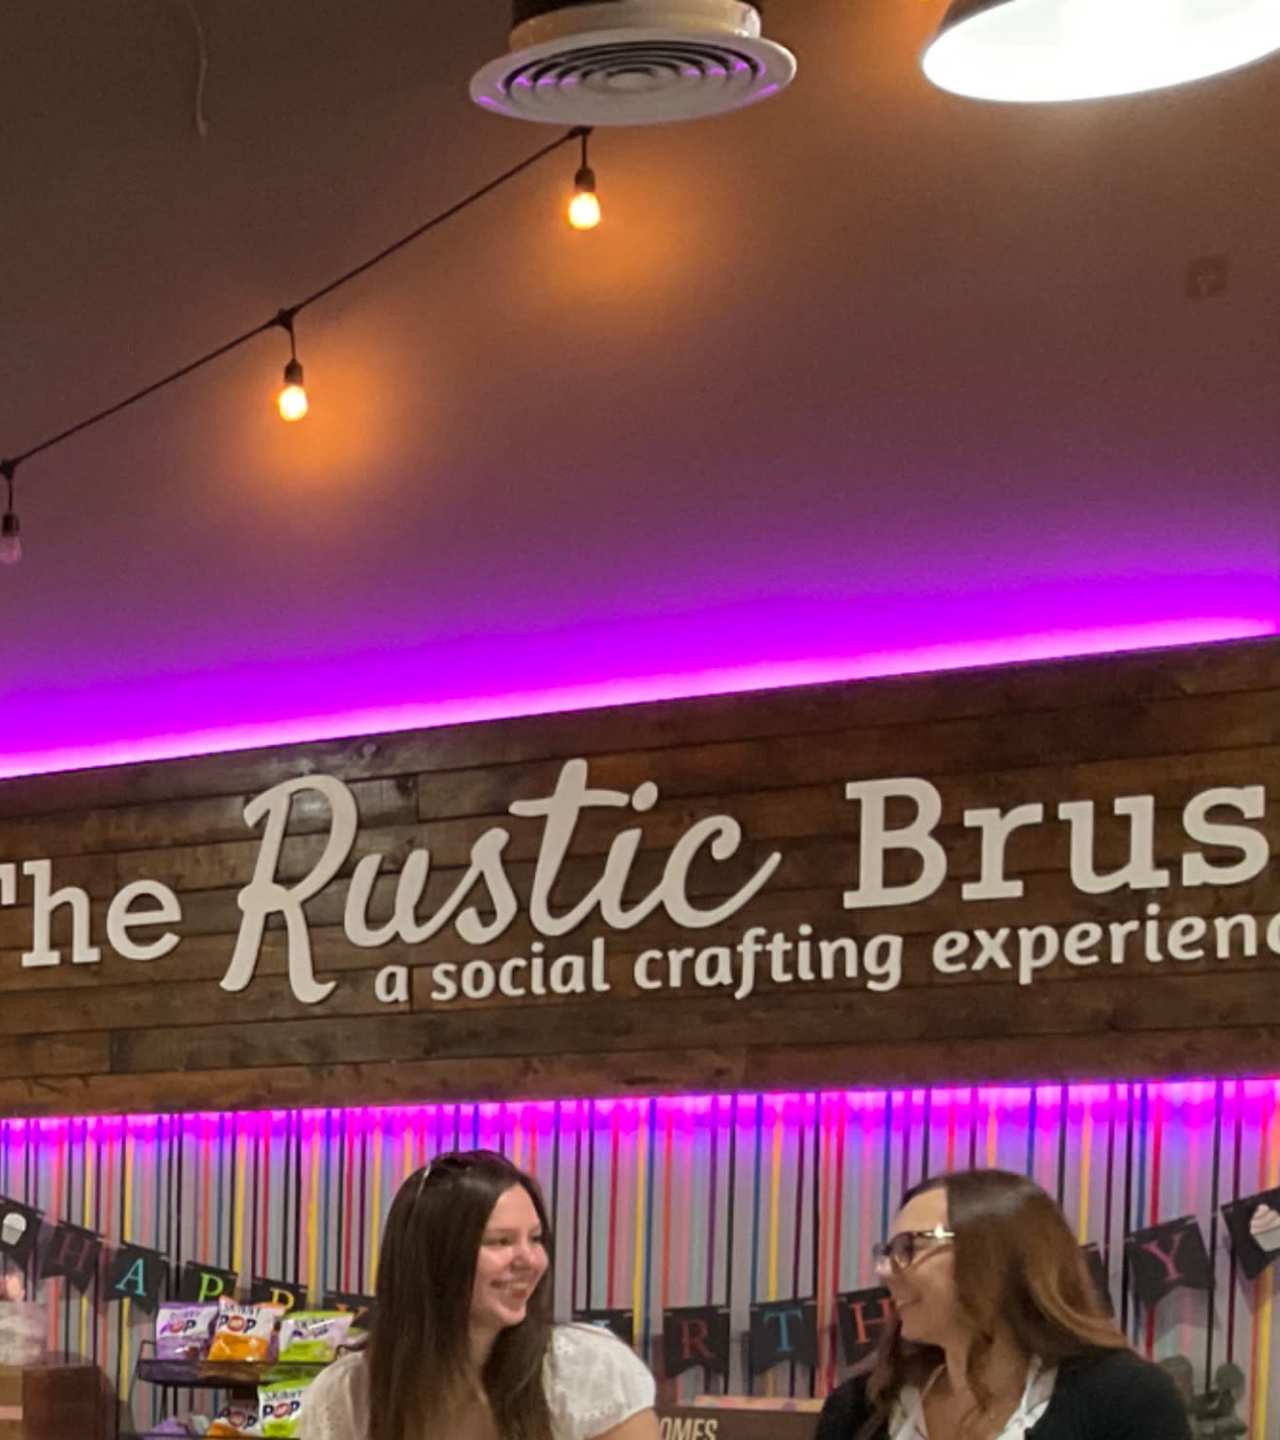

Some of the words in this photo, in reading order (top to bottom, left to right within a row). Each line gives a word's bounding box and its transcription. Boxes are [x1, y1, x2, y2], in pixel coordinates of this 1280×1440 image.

[220, 758, 782, 1004] Rustic
[843, 776, 1271, 910] Brus
[374, 964, 410, 1002] a
[431, 937, 610, 1002] social
[633, 924, 904, 1000] crafting
[218, 1314, 257, 1334] POP
